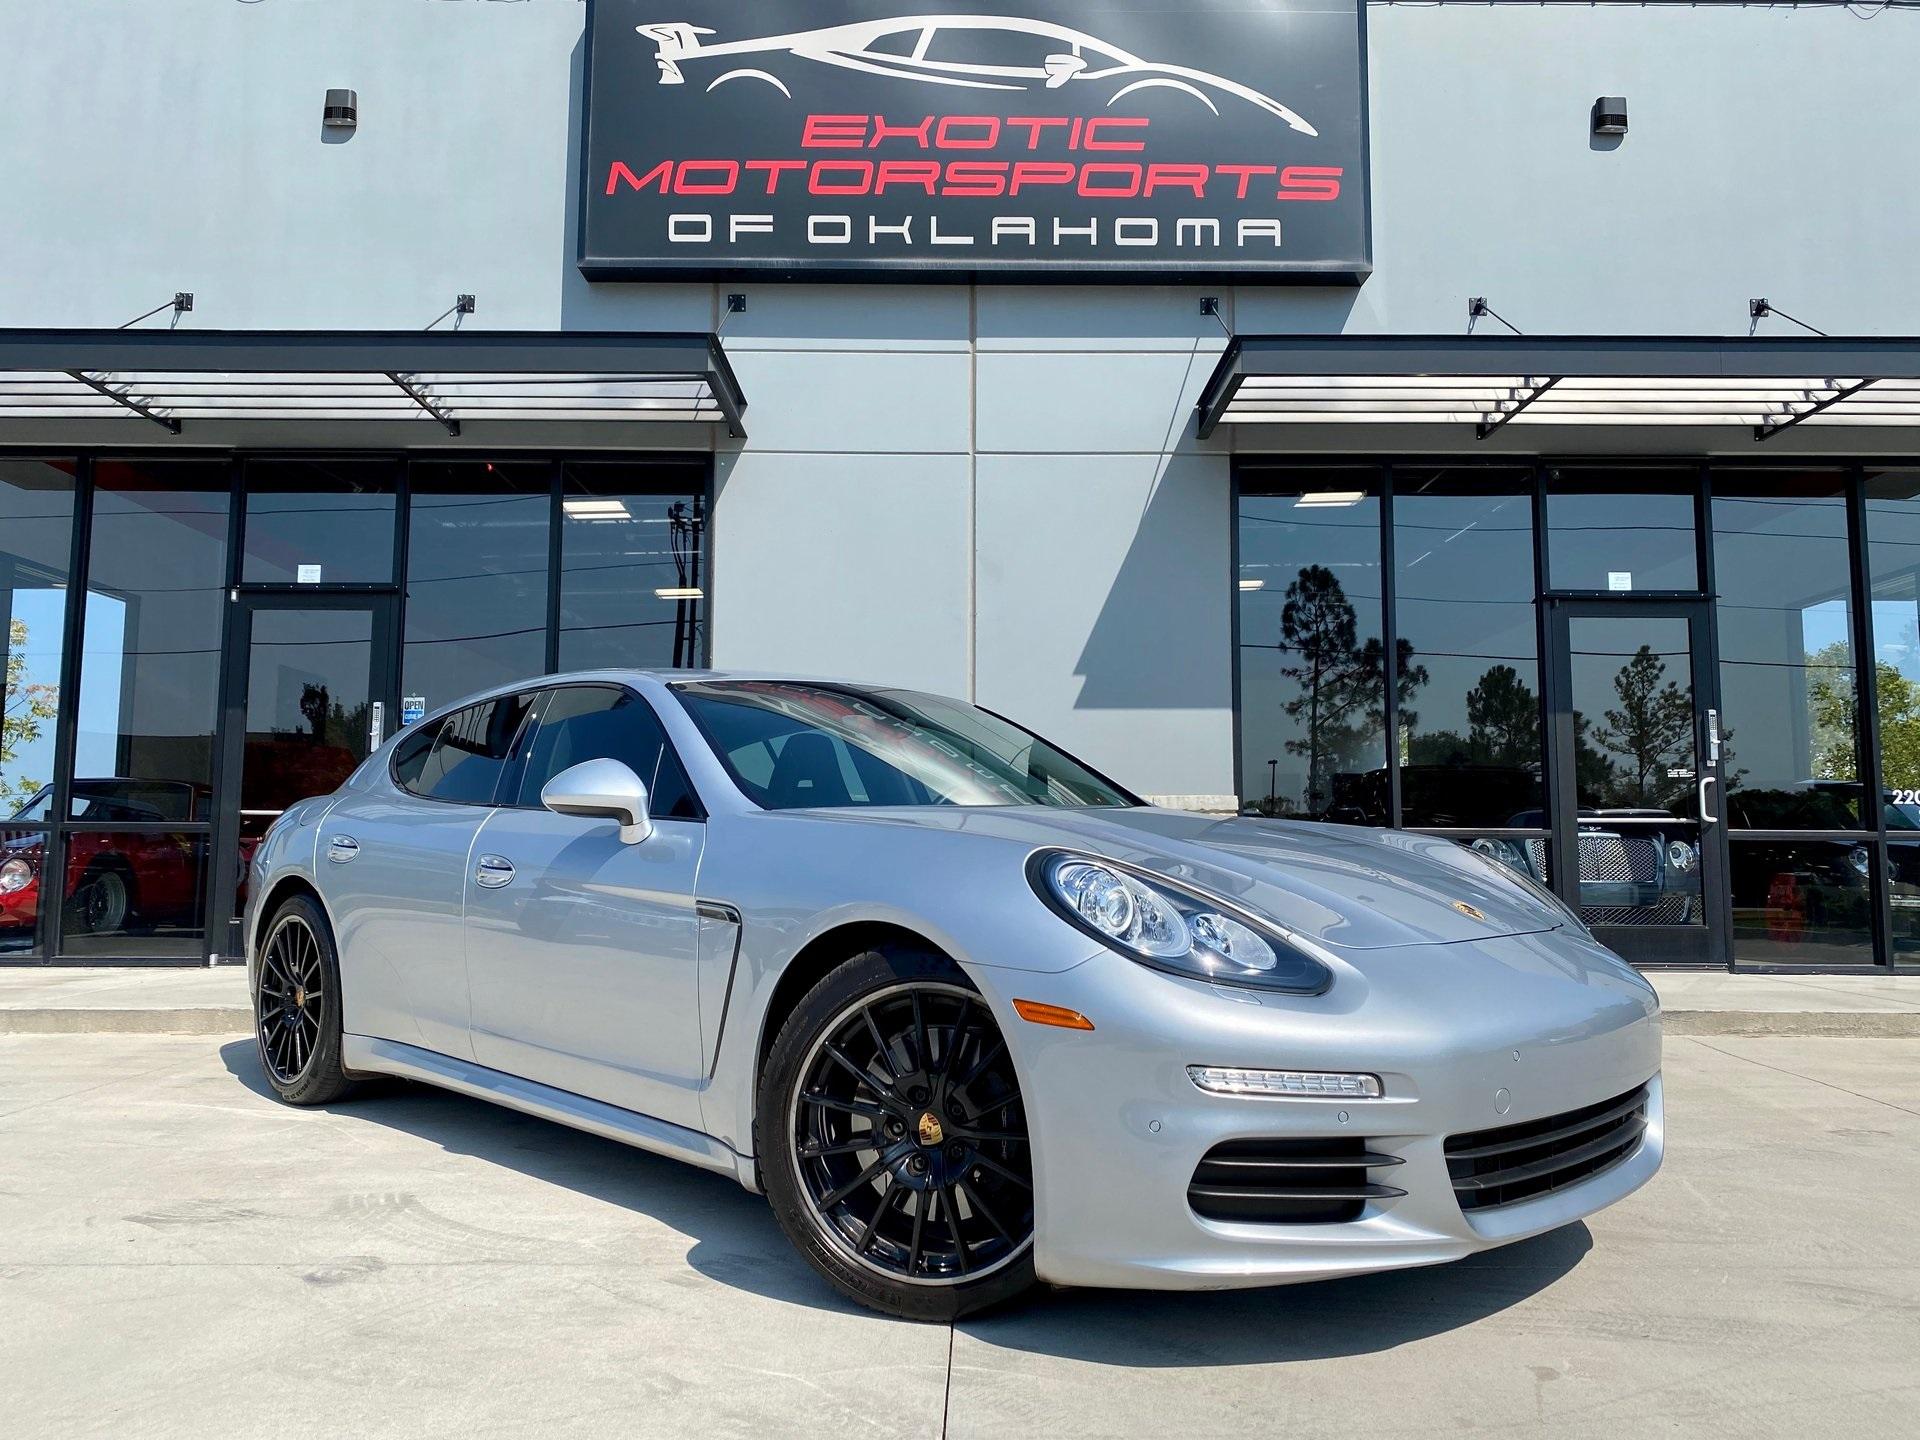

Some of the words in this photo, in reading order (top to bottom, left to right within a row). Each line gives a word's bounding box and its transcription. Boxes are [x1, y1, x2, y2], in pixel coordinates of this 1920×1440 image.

[801, 114, 1149, 152] EXOTIC
[605, 160, 1343, 201] MOTORSPORTS
[668, 214, 774, 243] OF
[807, 215, 1282, 247] OKLAHOMA
[404, 700, 424, 710] OPEN
